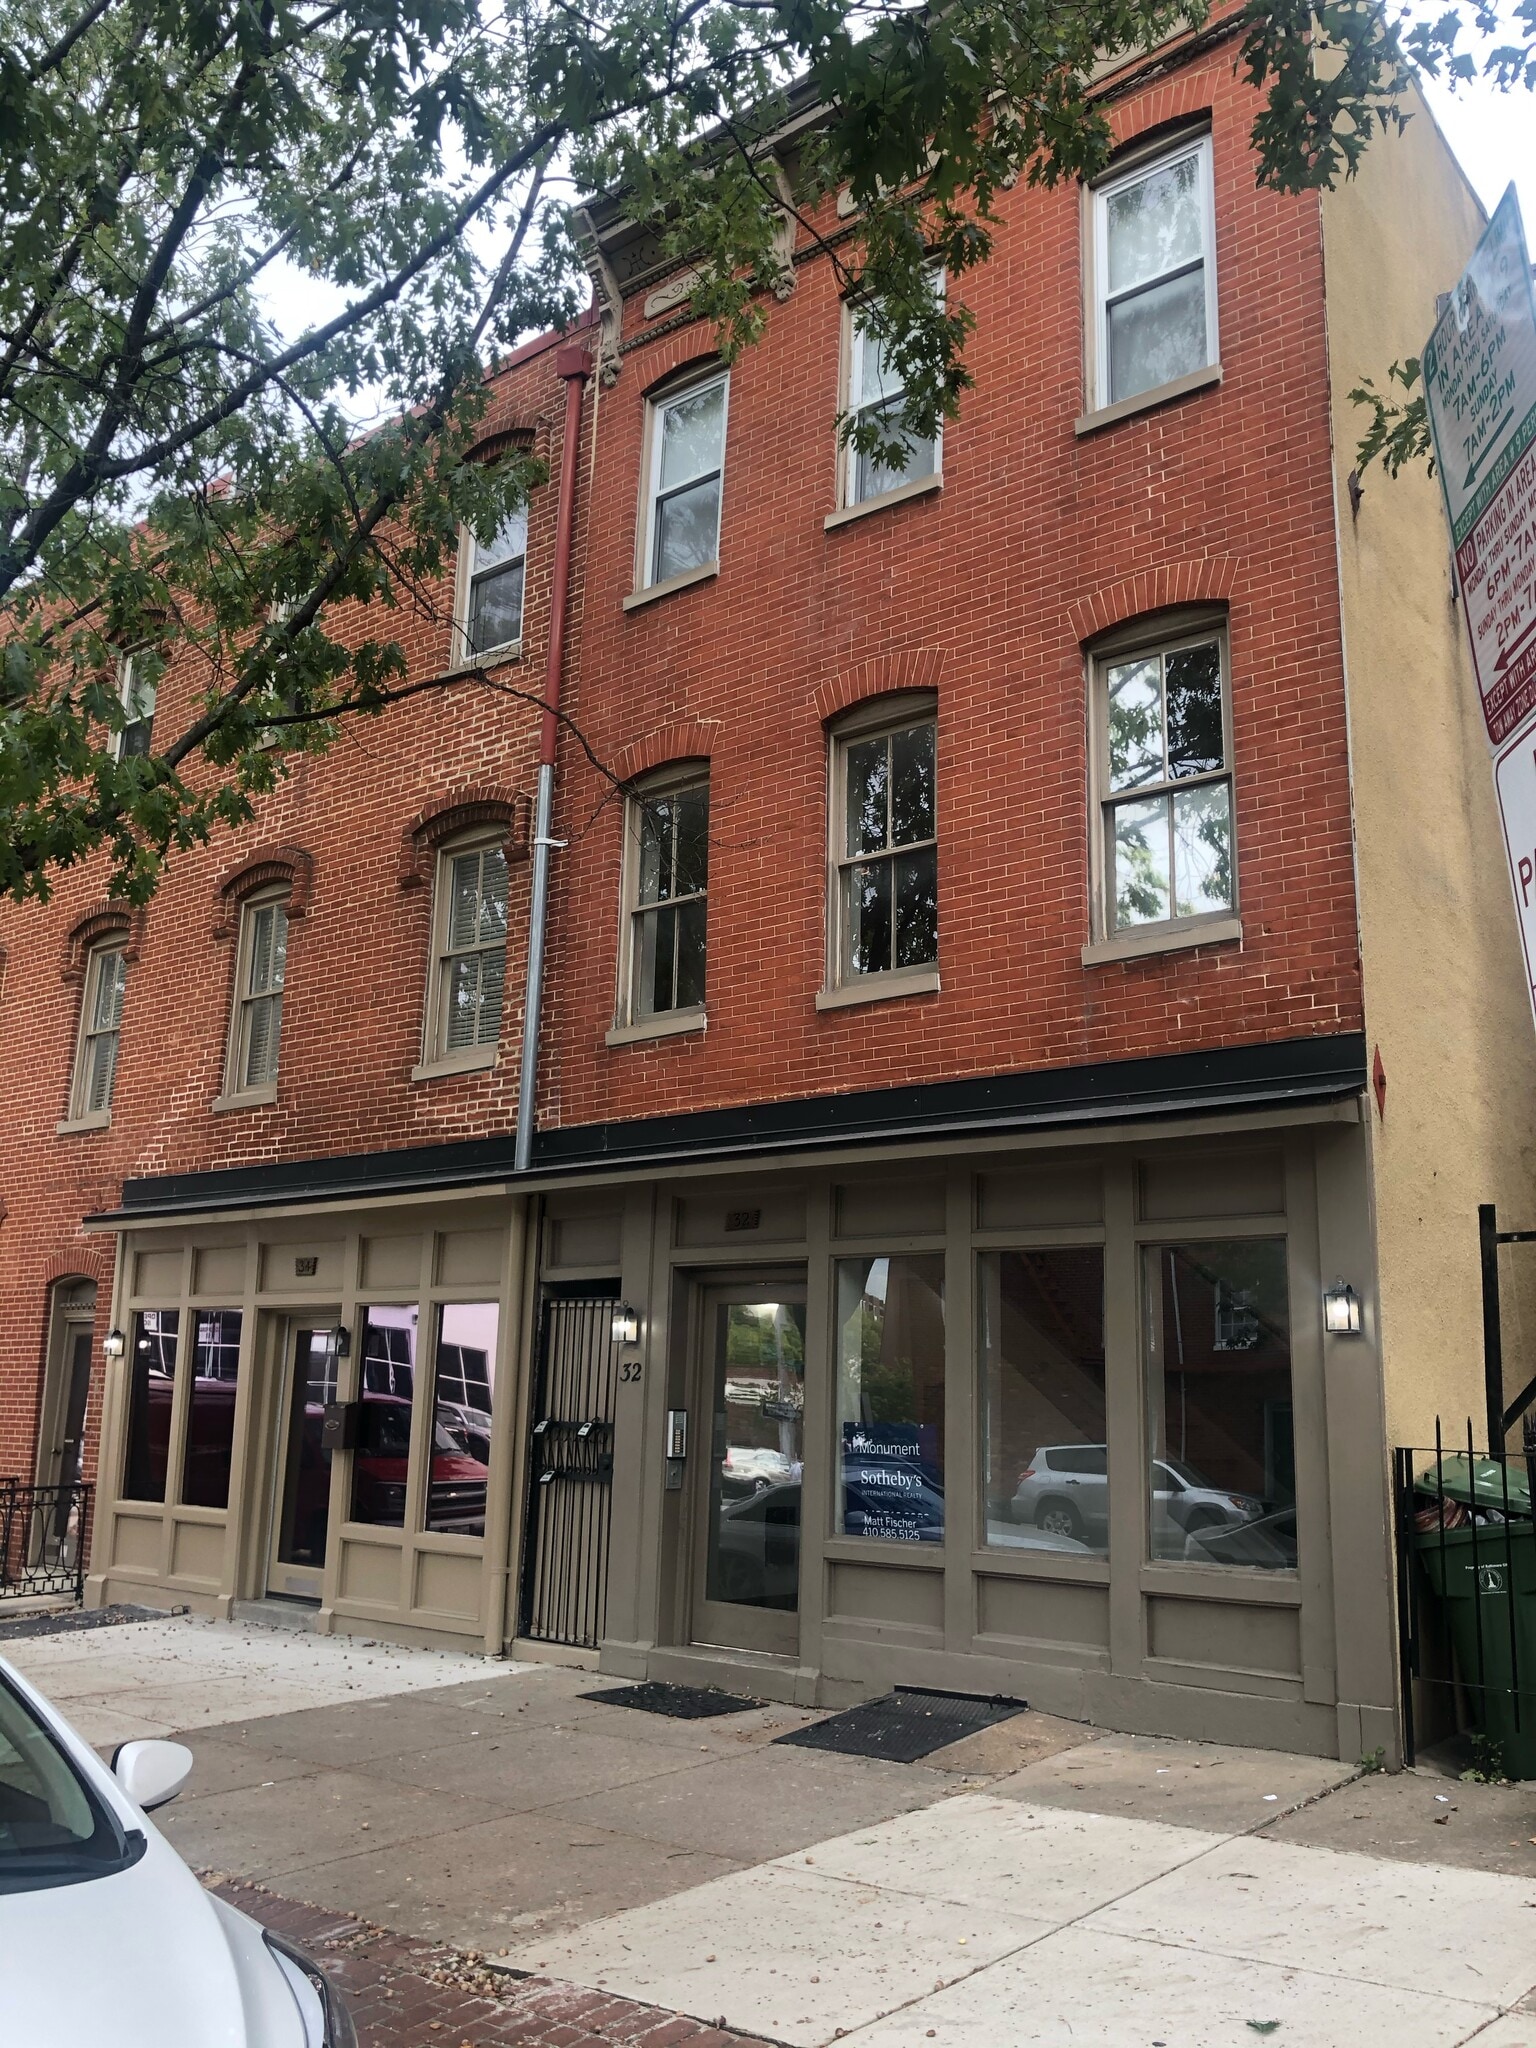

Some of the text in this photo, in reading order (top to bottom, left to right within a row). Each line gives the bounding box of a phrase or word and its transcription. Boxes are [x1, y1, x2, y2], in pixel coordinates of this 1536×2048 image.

[1428, 310, 1457, 377] 2 HOUR
[1438, 362, 1449, 393] IN
[1453, 303, 1484, 370] AREA
[1442, 364, 1464, 412] MONDAY
[1464, 339, 1480, 369] THRU
[1481, 284, 1511, 343] SATUDAY
[1453, 325, 1506, 421] 7AM-6PM
[1463, 369, 1515, 461] 7AM-2PM
[1470, 368, 1498, 422] SUNDAY
[1455, 507, 1476, 542] EXCEPT
[1476, 481, 1491, 509] WITH
[1491, 456, 1510, 489] AREA
[1521, 407, 1536, 444] PER
[1460, 453, 1536, 577] NO PARKING IN AREA
[1467, 557, 1488, 597] MONDAY
[1488, 536, 1504, 565] THRU
[1504, 502, 1527, 545] SUNDAY
[1478, 553, 1536, 640] SUNDAY THRU MONDAY
[1495, 580, 1536, 648] 2PM-7
[1486, 677, 1509, 716] EXCEPT
[1508, 659, 1526, 690] WITH
[620, 1363, 642, 1382] 32
[860, 1442, 921, 1456] Monument
[861, 1469, 922, 1490] Sotheby's
[864, 1515, 917, 1528] Matt Fischer
